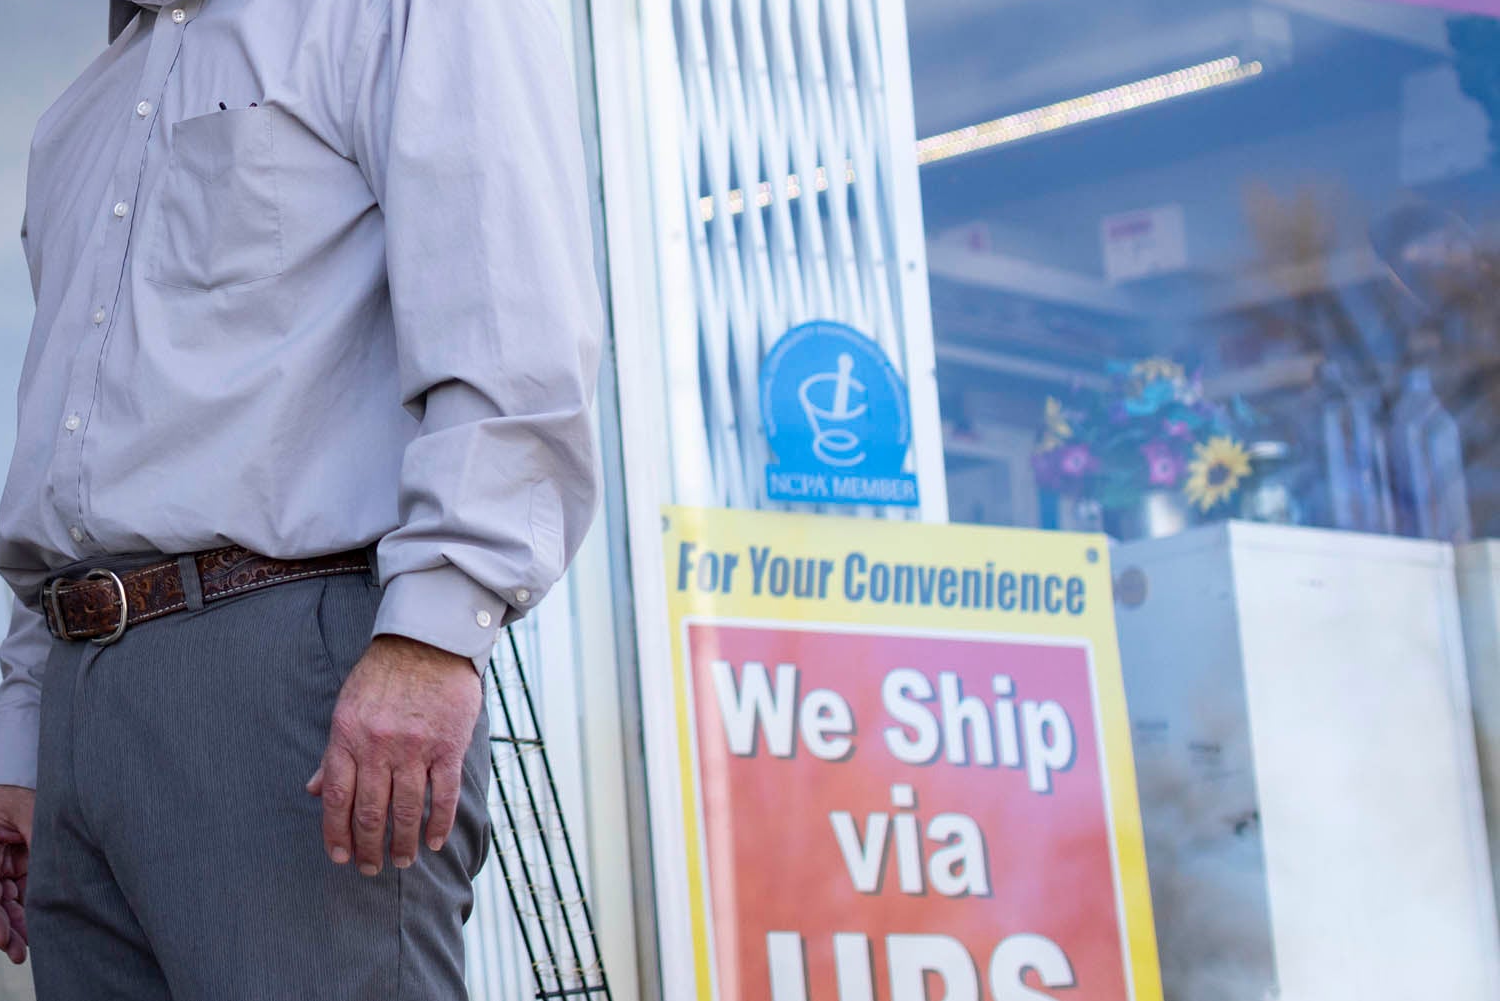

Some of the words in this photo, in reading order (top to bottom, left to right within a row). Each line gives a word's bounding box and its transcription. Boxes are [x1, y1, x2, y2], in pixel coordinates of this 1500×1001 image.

[770, 472, 829, 498] NCPA
[832, 475, 917, 501] MEMBER
[677, 541, 738, 595] For
[748, 545, 834, 599] Your
[843, 551, 1086, 616] Convenience
[710, 660, 855, 762] We
[881, 667, 1076, 794] Ship
[829, 783, 993, 897] via
